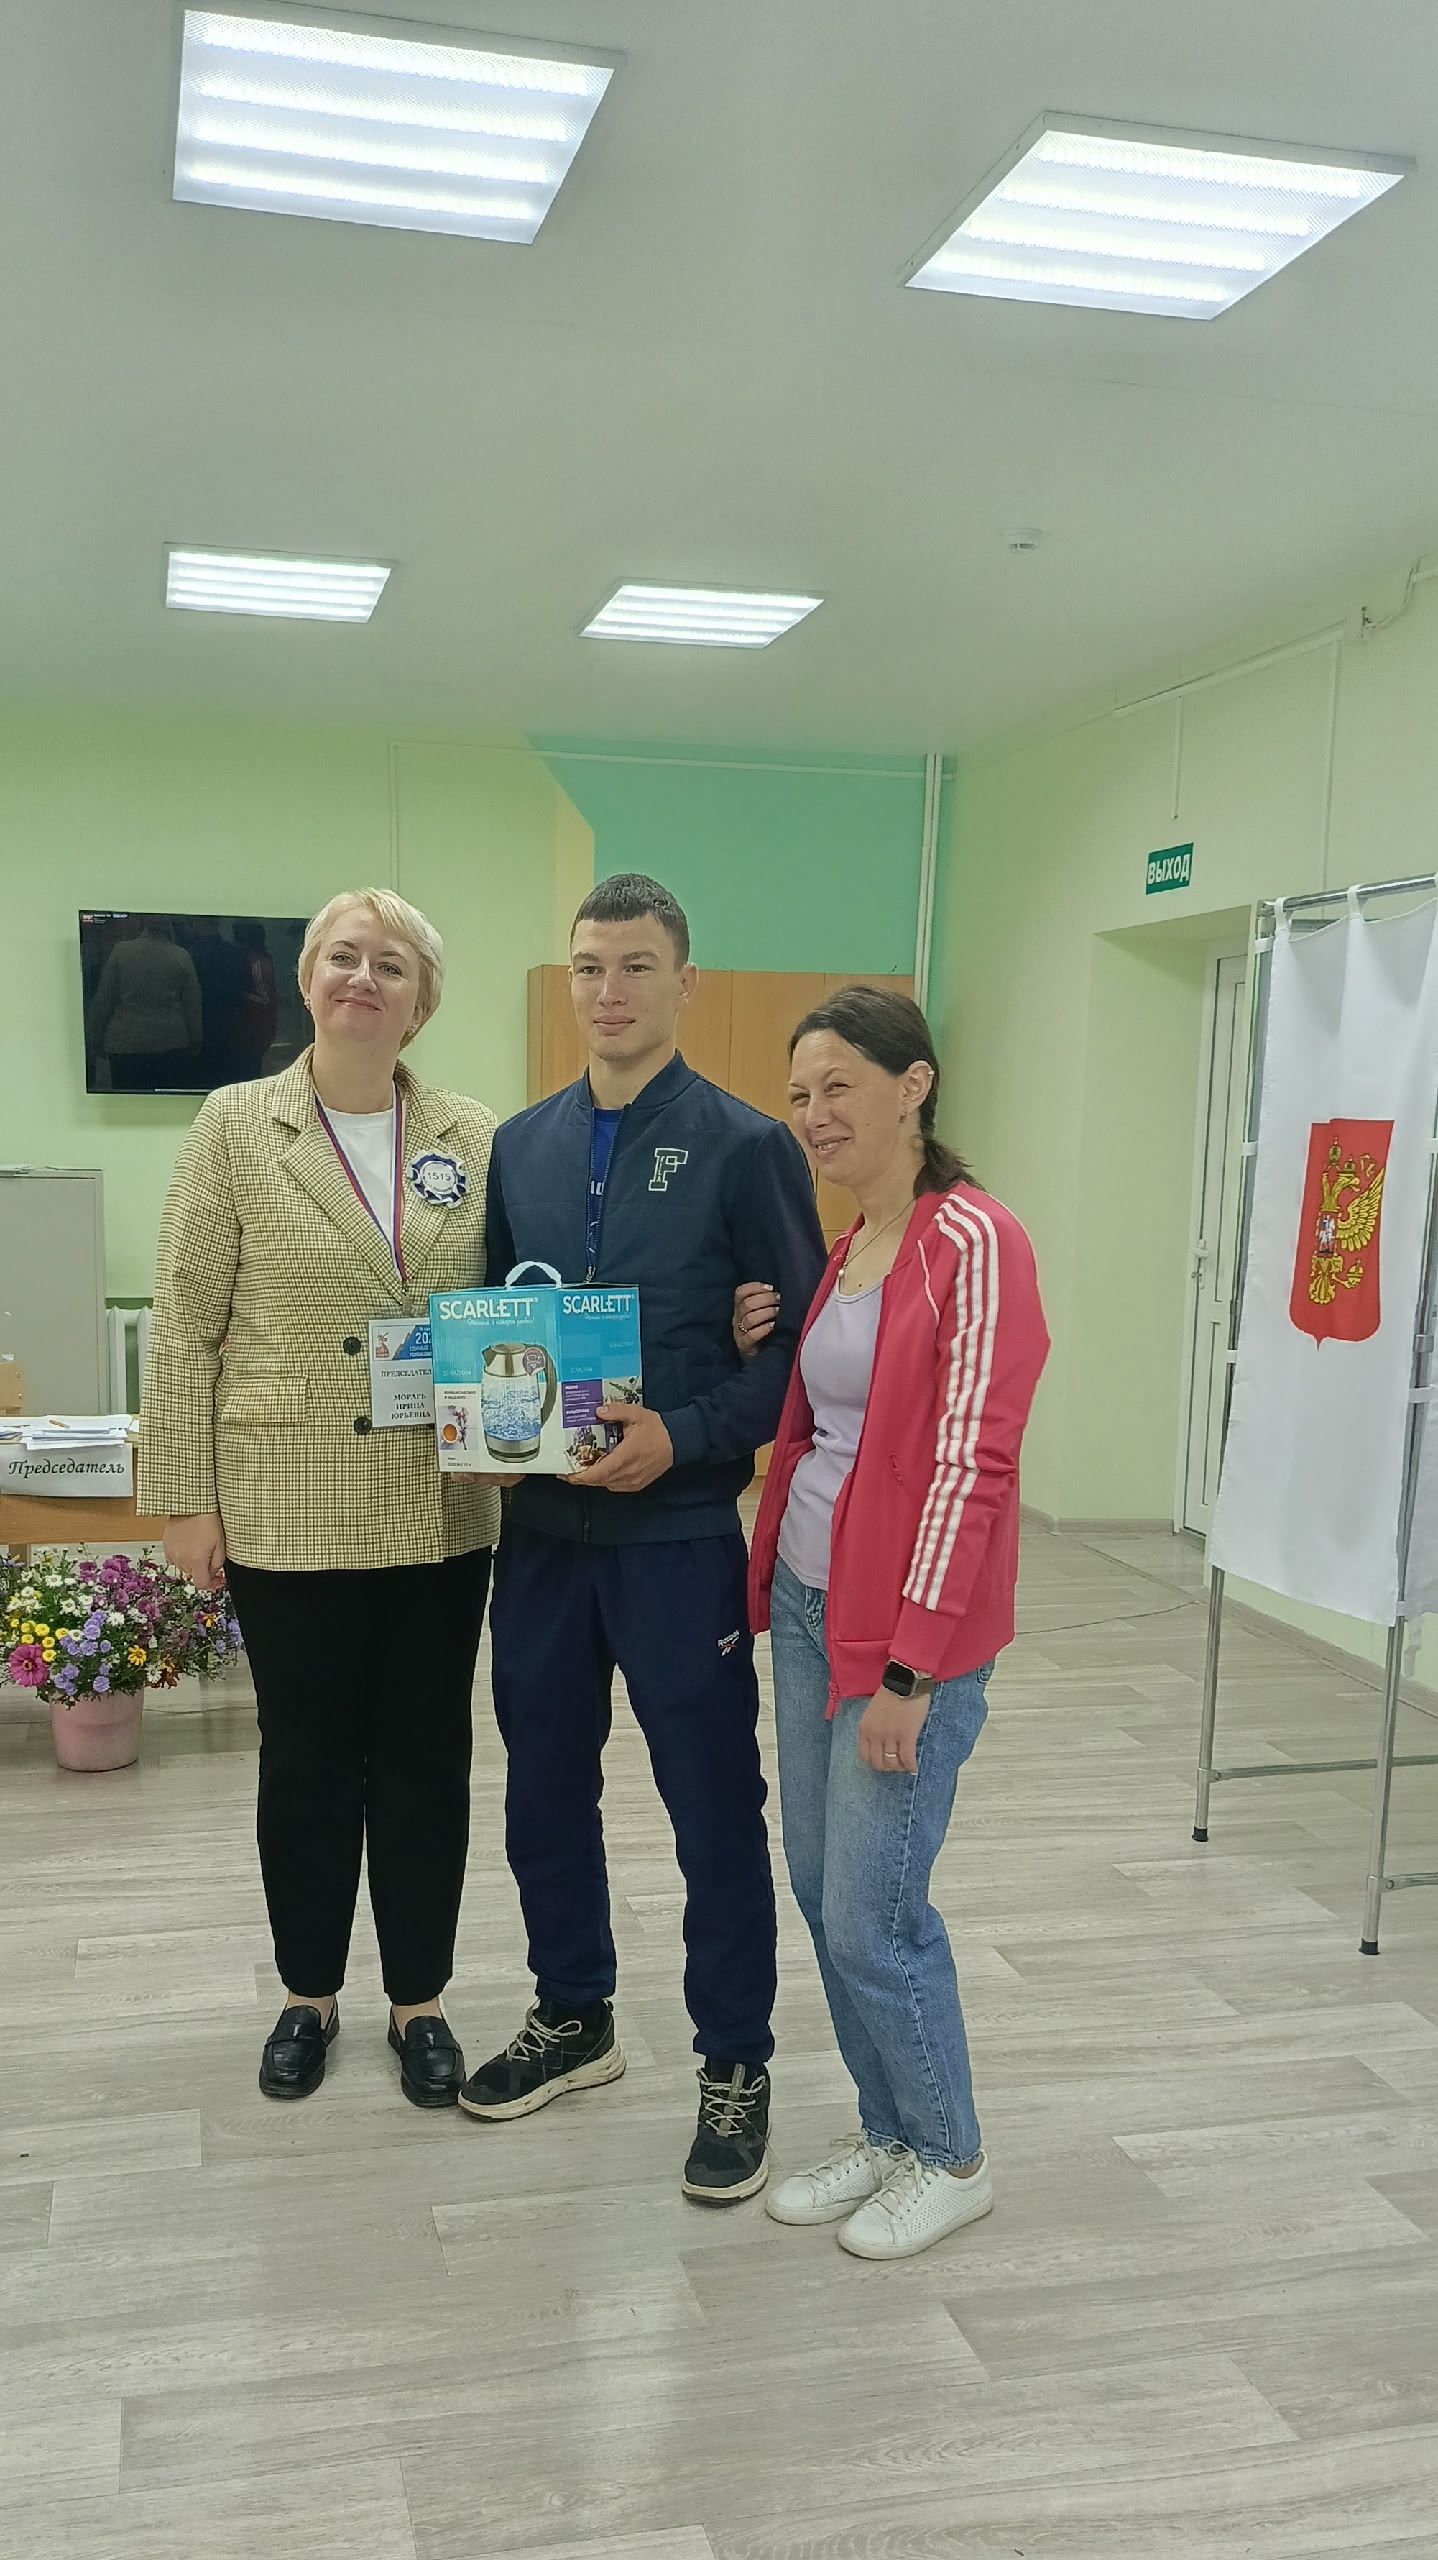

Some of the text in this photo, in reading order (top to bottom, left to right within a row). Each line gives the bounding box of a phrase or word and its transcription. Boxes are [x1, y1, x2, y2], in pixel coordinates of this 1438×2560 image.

[1147, 854, 1191, 884] ВЫХОД
[427, 1172, 452, 1181] 1515
[648, 1147, 688, 1192] F
[439, 1298, 533, 1319] SCARLETT
[562, 1295, 631, 1314] SCARLETT
[381, 1369, 432, 1377] ПРЕДСЕДАТЕЛ
[9, 1458, 125, 1478] Председатель
